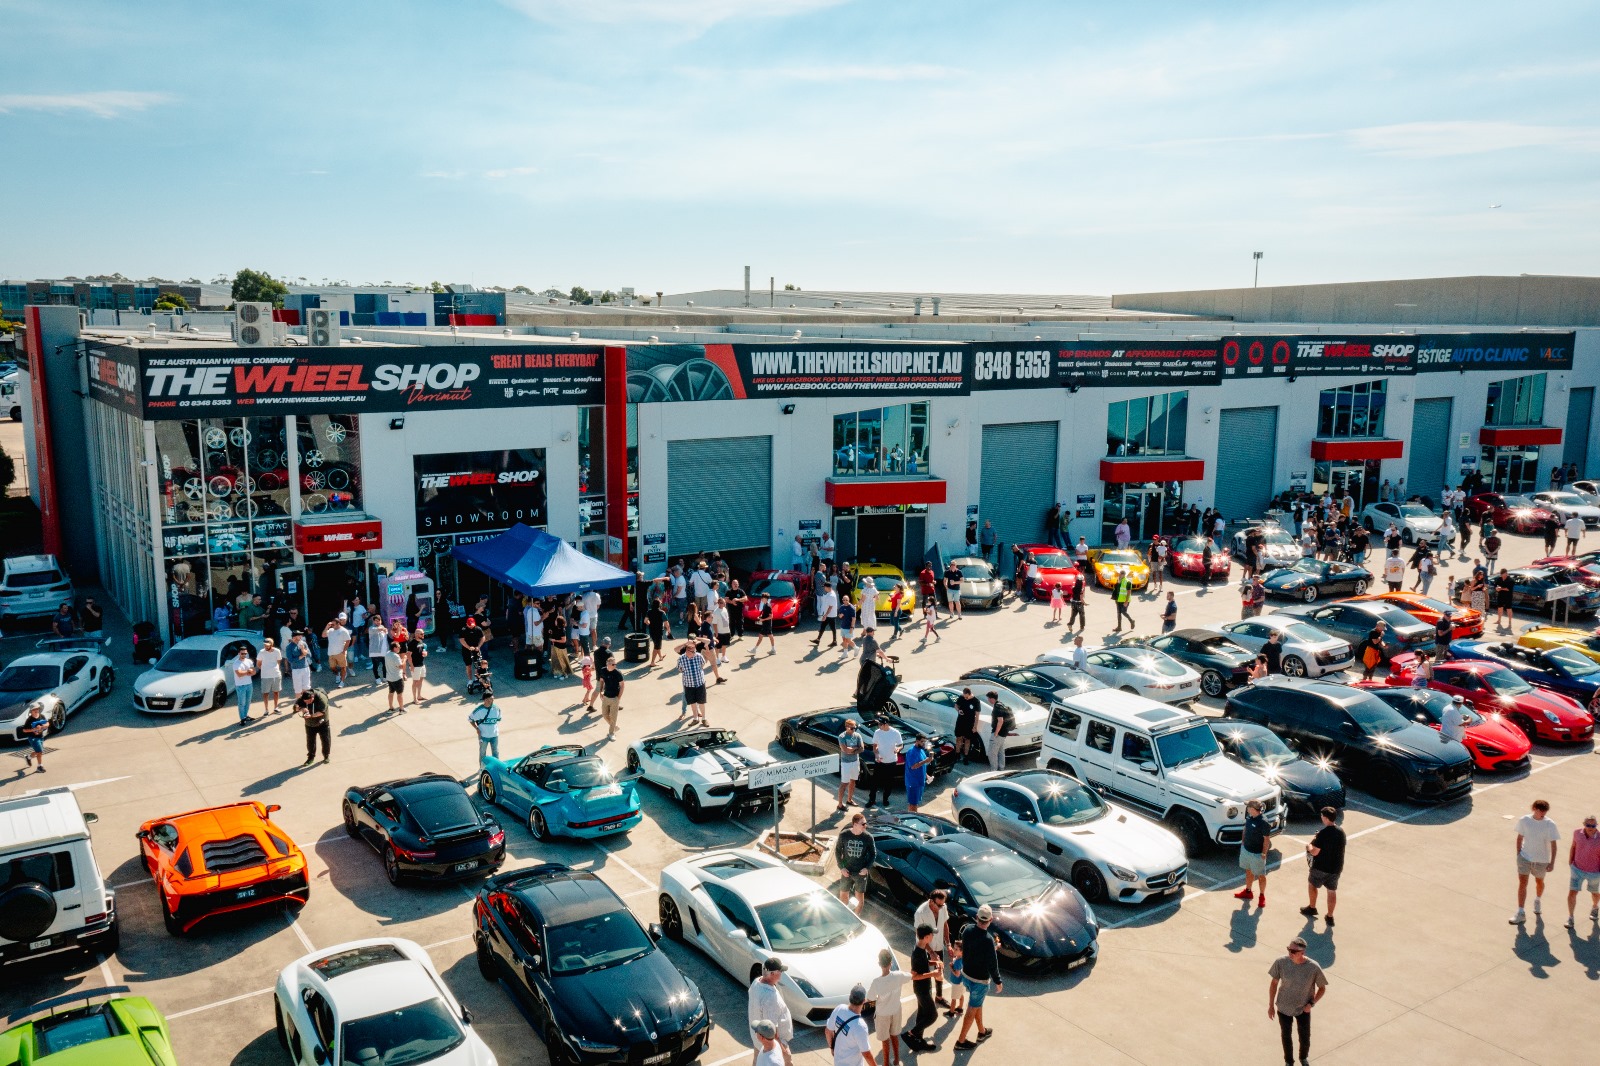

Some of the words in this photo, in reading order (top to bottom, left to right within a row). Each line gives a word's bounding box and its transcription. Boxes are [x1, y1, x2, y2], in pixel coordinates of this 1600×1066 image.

[1297, 344, 1324, 358] THE
[1324, 344, 1372, 358] WHEEL
[1372, 344, 1415, 356] SHOP
[1452, 348, 1484, 362] AUTO
[1485, 348, 1530, 362] CLINIC
[1540, 348, 1566, 358] VACC
[166, 358, 222, 366] AUSTRALIAN
[524, 354, 552, 368] DEALS
[751, 352, 962, 374] WWW.THEWHEELSHOP.NET.AU
[975, 352, 1012, 380] 8348
[1016, 350, 1050, 378] 5353
[117, 362, 136, 392] SHOP
[146, 366, 232, 397] THE
[234, 365, 369, 393] WHEEL
[372, 363, 480, 391] SHOP
[256, 396, 366, 404] WWW.THEWHEELSHOP.NET.AU
[400, 383, 472, 405] Derrimut
[162, 454, 173, 480] SHOP
[421, 476, 450, 489] THE
[450, 472, 498, 486] WHEEL
[498, 470, 539, 484] SHOP
[425, 508, 539, 527] SHOWROOM
[324, 532, 354, 542] WHEEL
[171, 583, 180, 608] SHOP
[766, 765, 797, 777] MIMOSA
[802, 760, 830, 770] Customer
[769, 773, 796, 782] HOMES
[804, 768, 828, 777] Parking
